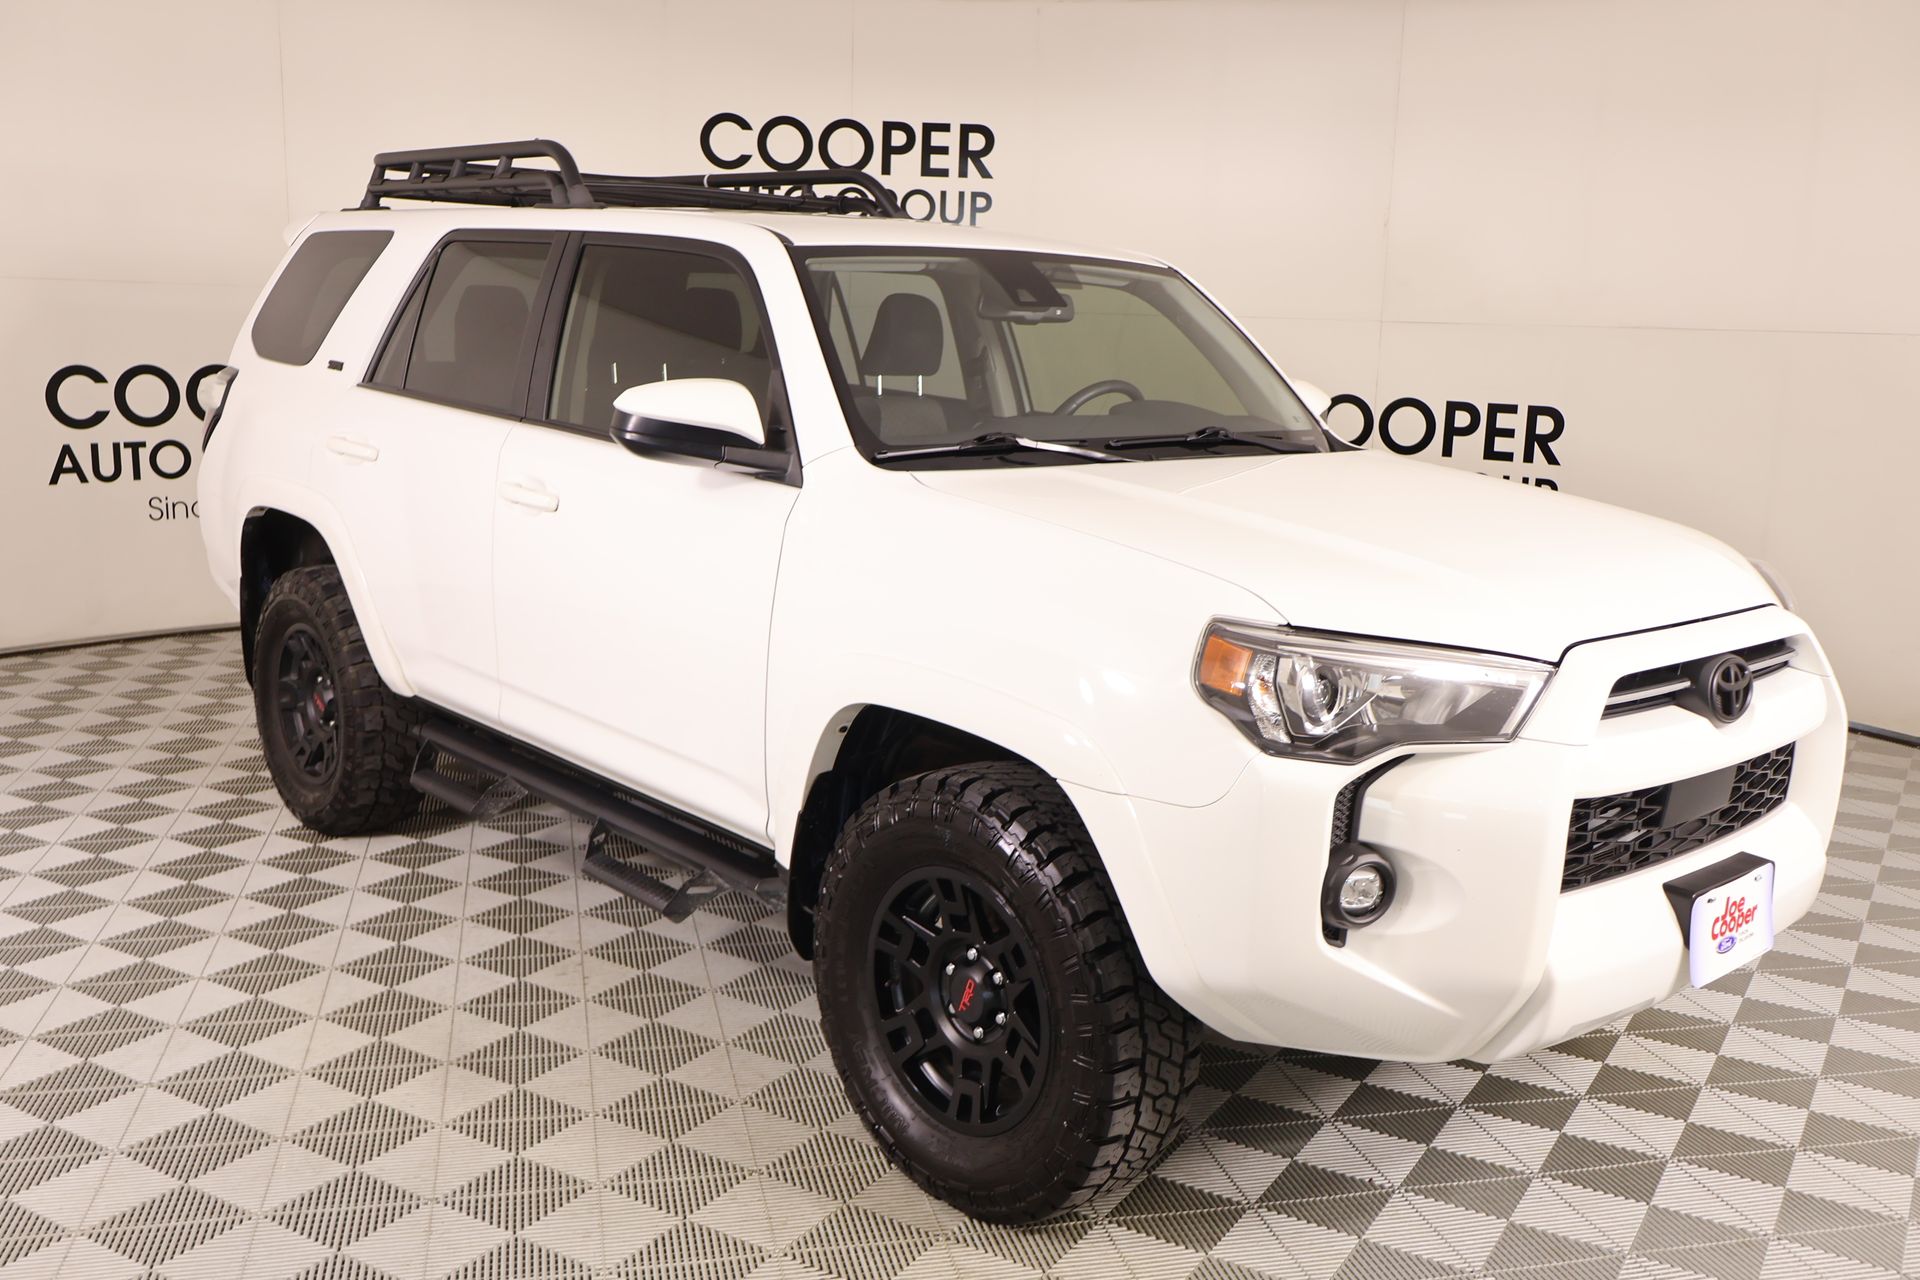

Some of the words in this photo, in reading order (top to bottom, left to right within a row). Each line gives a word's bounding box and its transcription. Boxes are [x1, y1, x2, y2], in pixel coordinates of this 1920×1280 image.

[700, 112, 995, 179] COOPER
[838, 186, 992, 226] OUP
[45, 364, 228, 430] COO
[1327, 393, 1565, 466] OOPER
[48, 439, 192, 486] AUTO
[148, 495, 200, 521] Sinc
[1711, 905, 1758, 941] Cooper
[1721, 896, 1746, 920] Joe
[959, 978, 976, 1011] TRD
